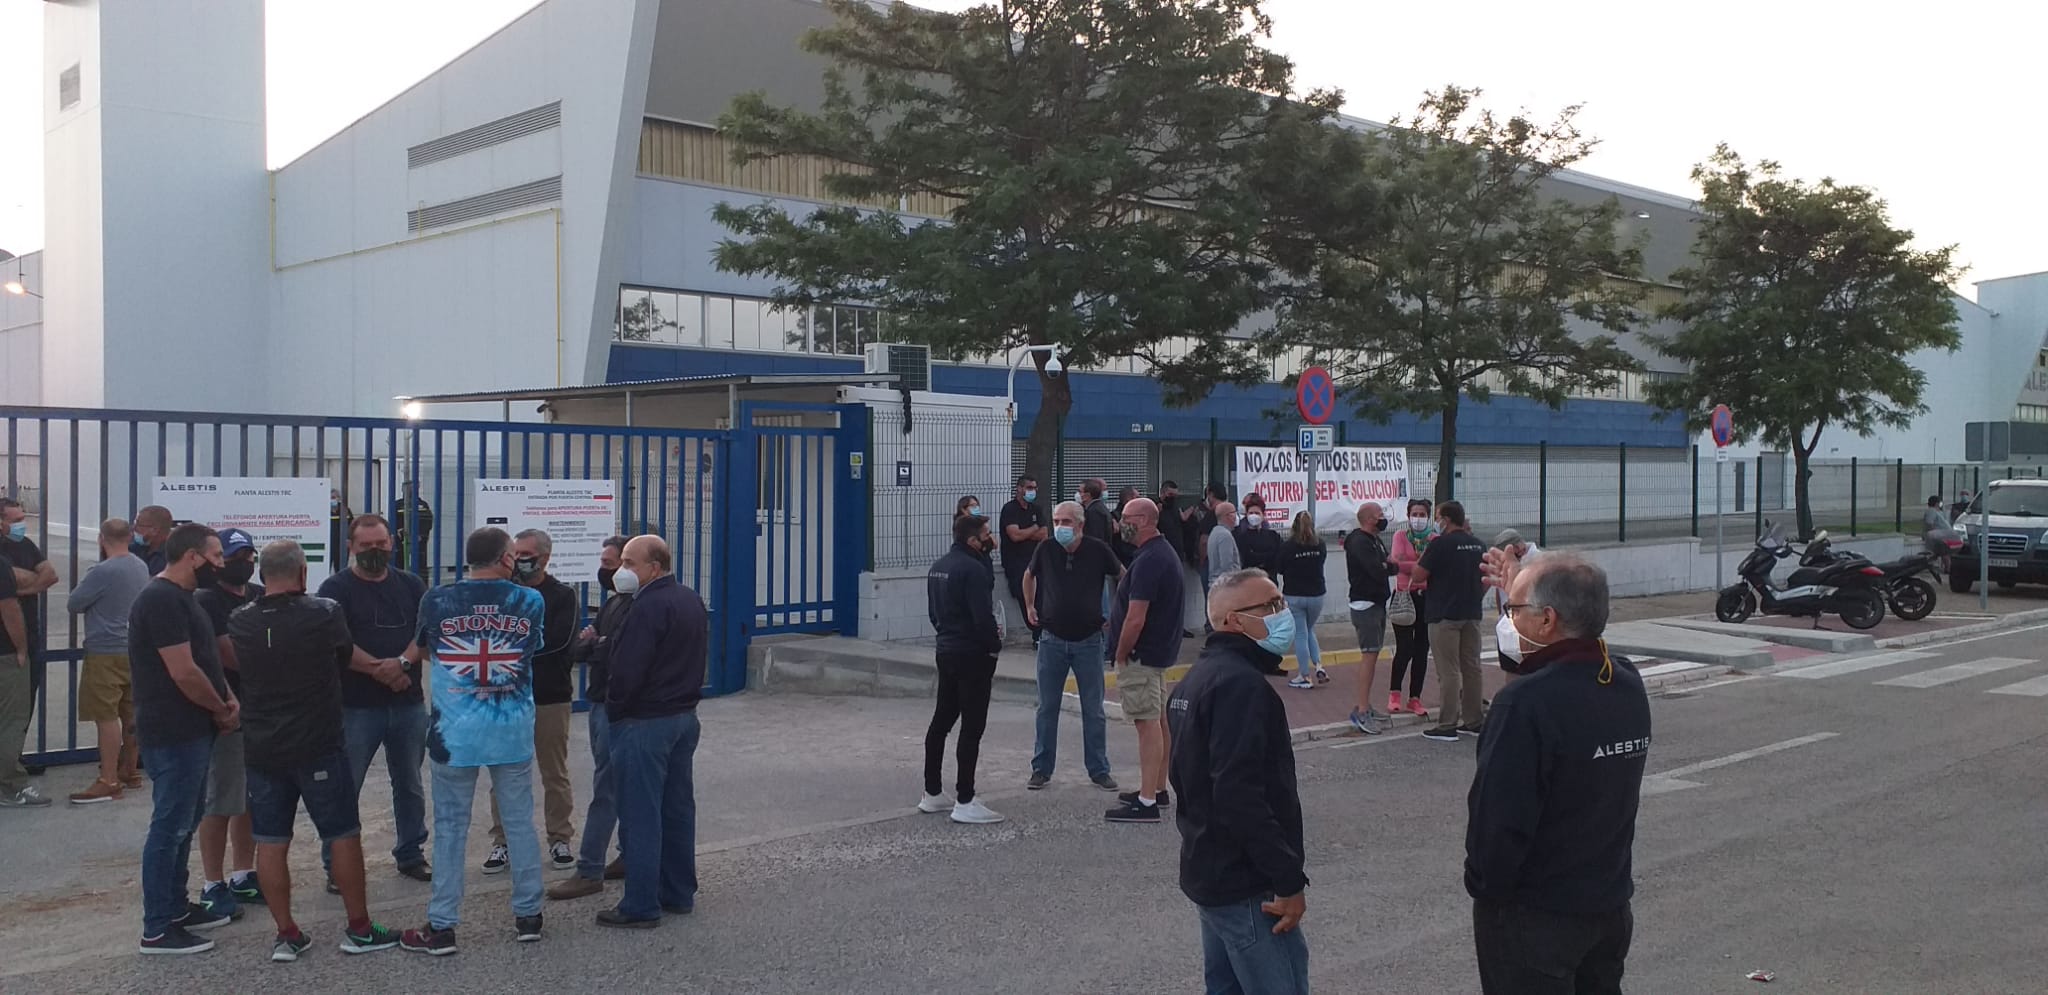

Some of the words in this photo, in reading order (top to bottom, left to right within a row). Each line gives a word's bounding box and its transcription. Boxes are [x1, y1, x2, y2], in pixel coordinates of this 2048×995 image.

[1303, 432, 1312, 447] P
[1244, 451, 1262, 472] NO
[1272, 451, 1293, 472] LOS
[1296, 452, 1349, 472] DEPIDOS
[1351, 452, 1362, 471] EN
[1364, 451, 1403, 471] ALESTIS
[1315, 480, 1340, 501] SEPI
[473, 604, 499, 615] THE
[441, 614, 531, 635] STONES
